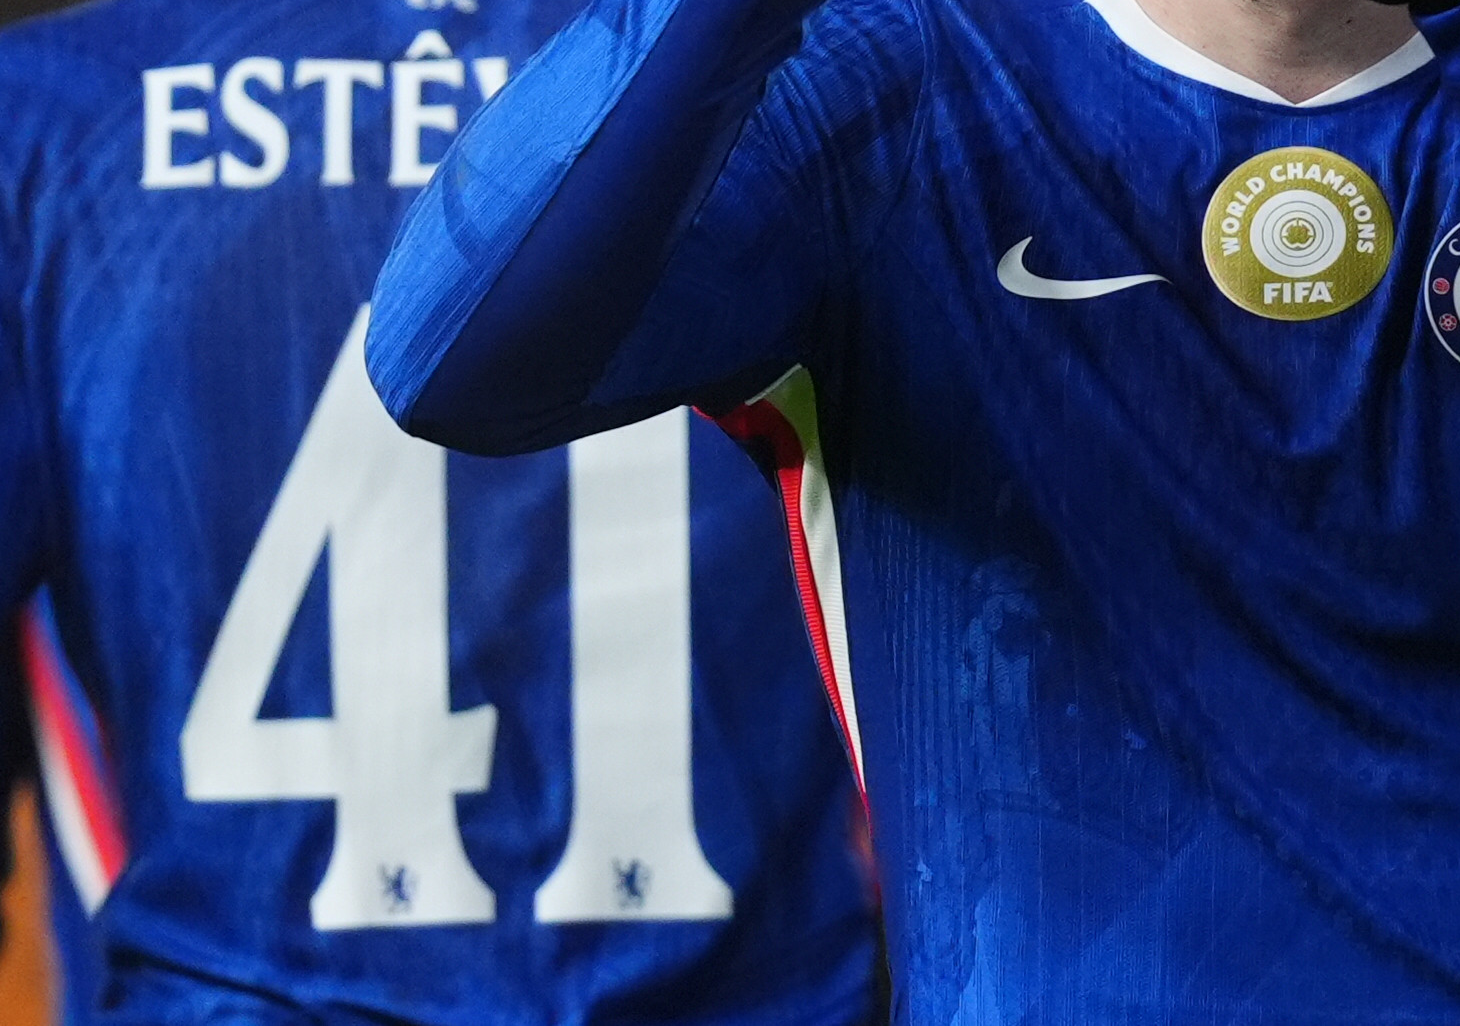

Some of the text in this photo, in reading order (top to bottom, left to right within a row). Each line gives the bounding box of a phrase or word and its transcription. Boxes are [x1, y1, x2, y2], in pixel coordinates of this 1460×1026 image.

[140, 29, 509, 190] ESTÊ
[1219, 161, 1377, 257] WORLD CHAMPIONS
[1263, 281, 1334, 305] FIFA
[181, 300, 734, 931] 41
